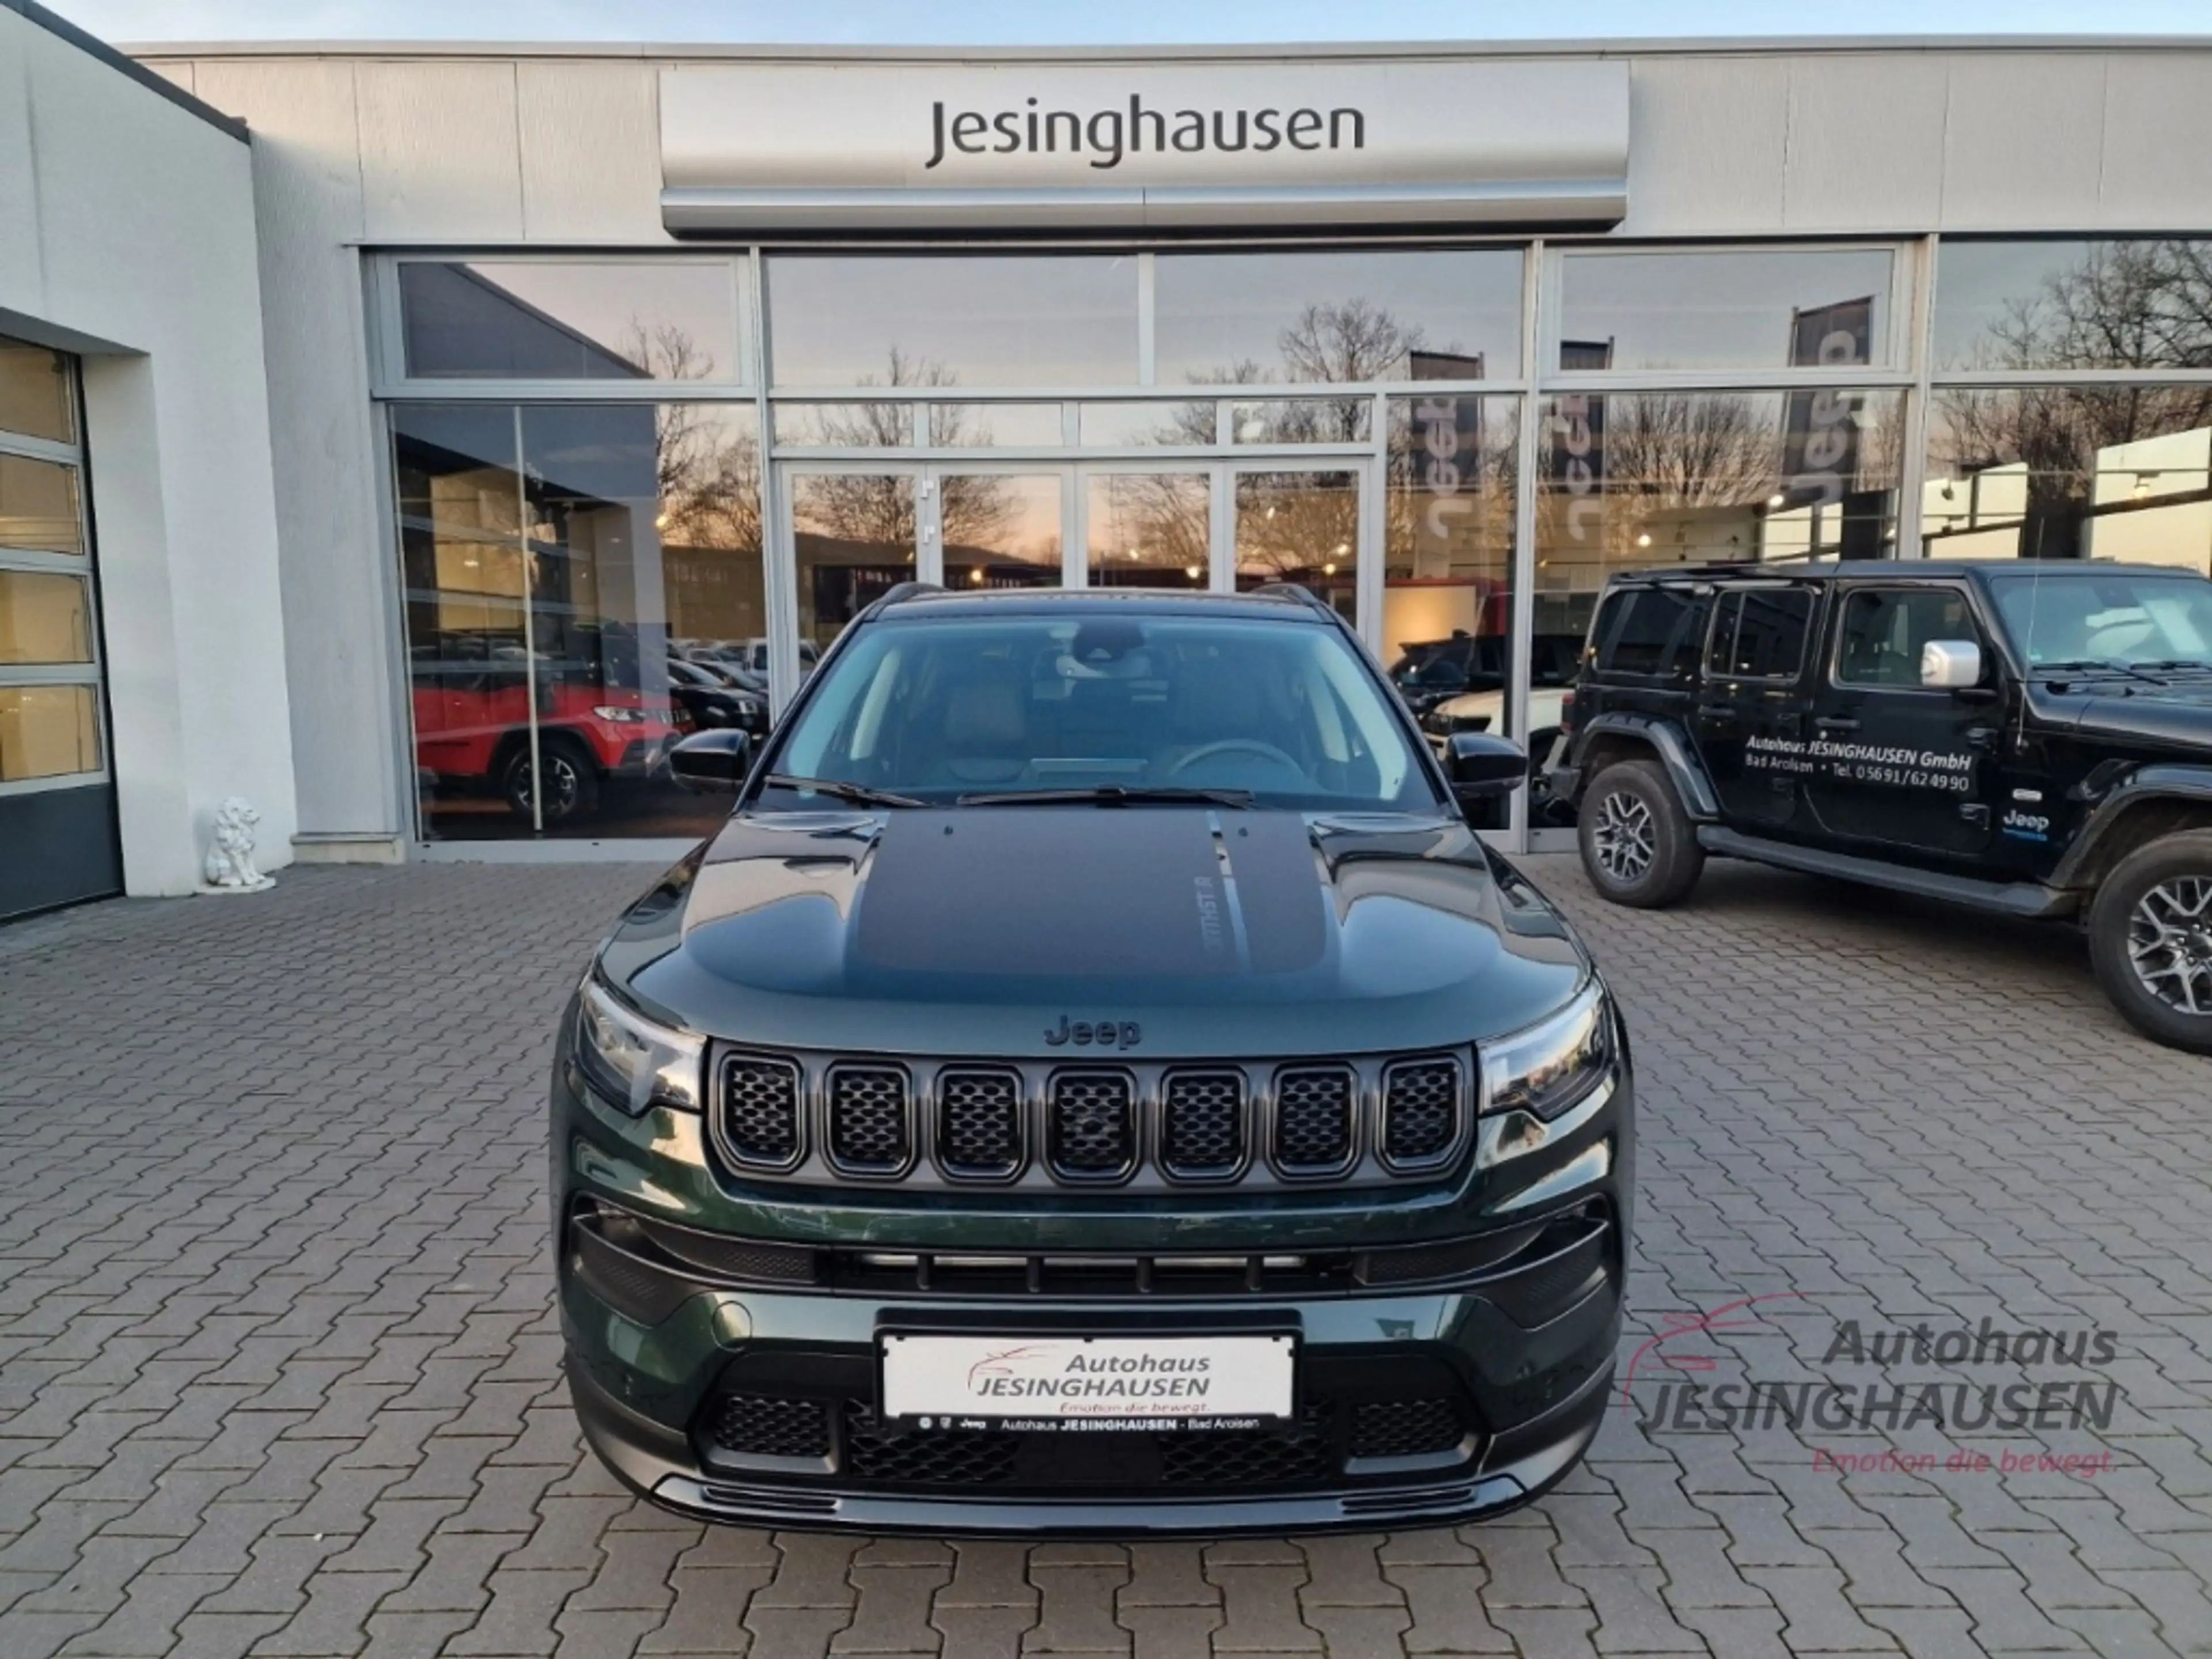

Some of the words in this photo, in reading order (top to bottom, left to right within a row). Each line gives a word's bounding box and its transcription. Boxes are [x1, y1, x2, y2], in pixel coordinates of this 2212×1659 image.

[925, 93, 1364, 169] Jesinghausen
[1746, 735, 1806, 753] Autohaus
[1807, 740, 1918, 765] JESINGHAUSEN
[1920, 751, 1972, 770] GmbH
[2003, 809, 2050, 832] Jeep
[1043, 1014, 1142, 1051] Jeep
[1065, 1354, 1210, 1373] Autohaus
[976, 1377, 1210, 1397] JESINGHAUSEN
[1001, 1419, 1058, 1431] Autohaus
[1060, 1419, 1177, 1431] JESINGHAUSEN
